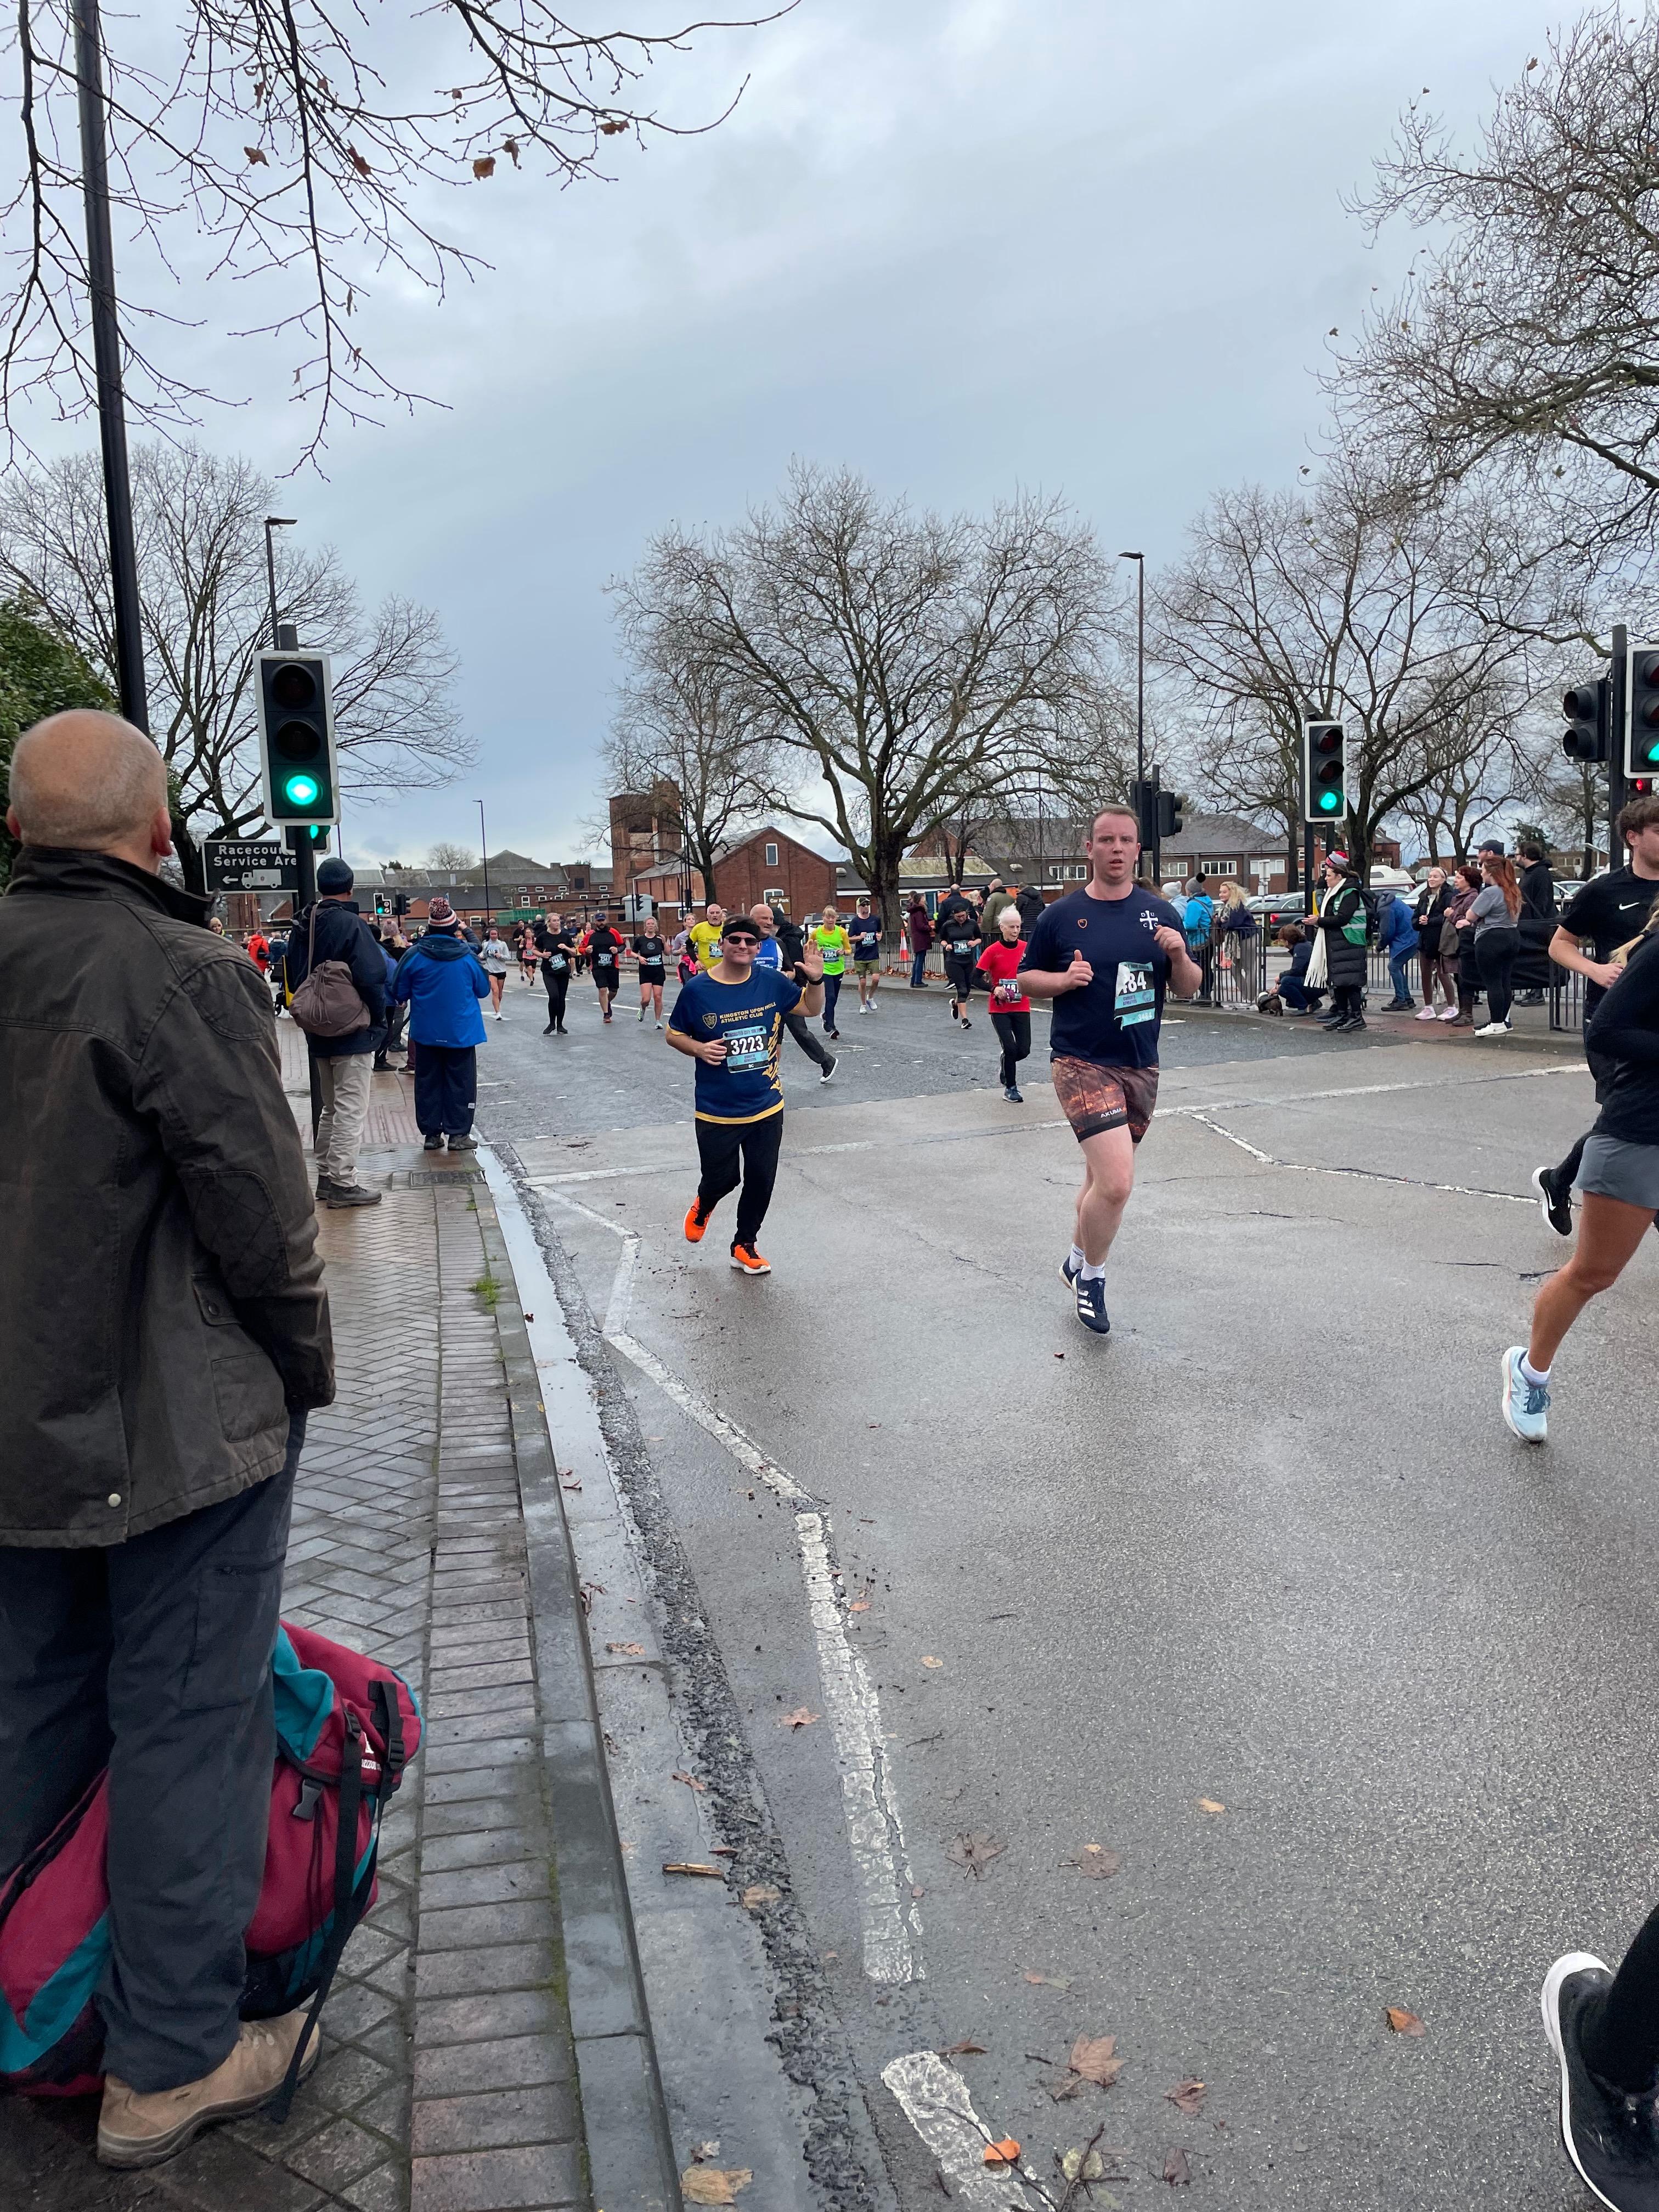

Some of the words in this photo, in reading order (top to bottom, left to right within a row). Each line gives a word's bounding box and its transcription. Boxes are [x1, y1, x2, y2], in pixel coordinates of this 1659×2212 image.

[218, 845, 282, 856] Racecour
[213, 856, 267, 867] Service
[274, 855, 297, 866] Are
[719, 1010, 749, 1019] KINGSTON
[721, 1014, 748, 1024] ATHLETIC
[1137, 1012, 1153, 1021] 3484
[730, 1035, 764, 1055] 3223
[1101, 1108, 1123, 1118] AKUMA
